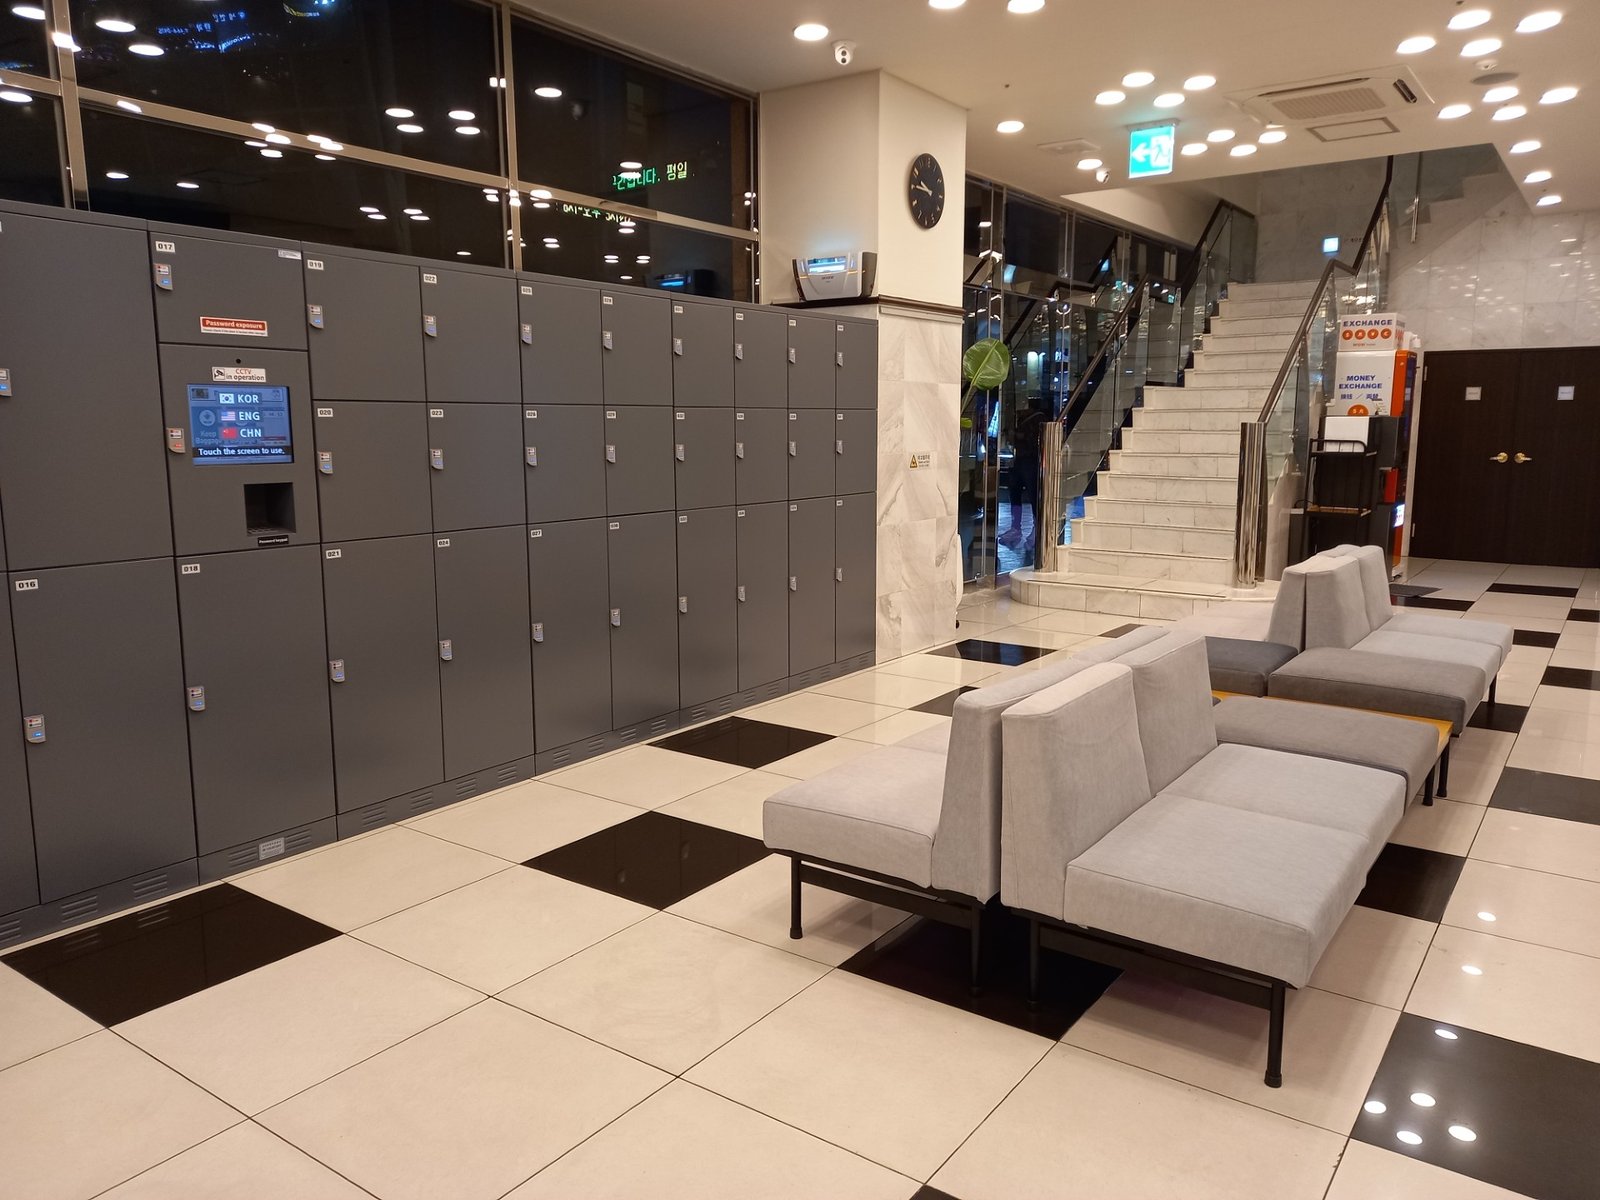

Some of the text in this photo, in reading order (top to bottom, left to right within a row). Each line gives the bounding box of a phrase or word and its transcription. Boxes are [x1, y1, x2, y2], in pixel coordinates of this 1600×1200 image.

[666, 161, 687, 180] 평일
[205, 319, 235, 328] Password
[1343, 319, 1392, 327] EXCHANGE
[237, 394, 260, 404] KOR
[238, 411, 260, 421] ENG
[240, 428, 262, 438] CHN
[198, 447, 222, 456] Touch
[223, 447, 236, 455] the
[18, 581, 36, 589] 016
